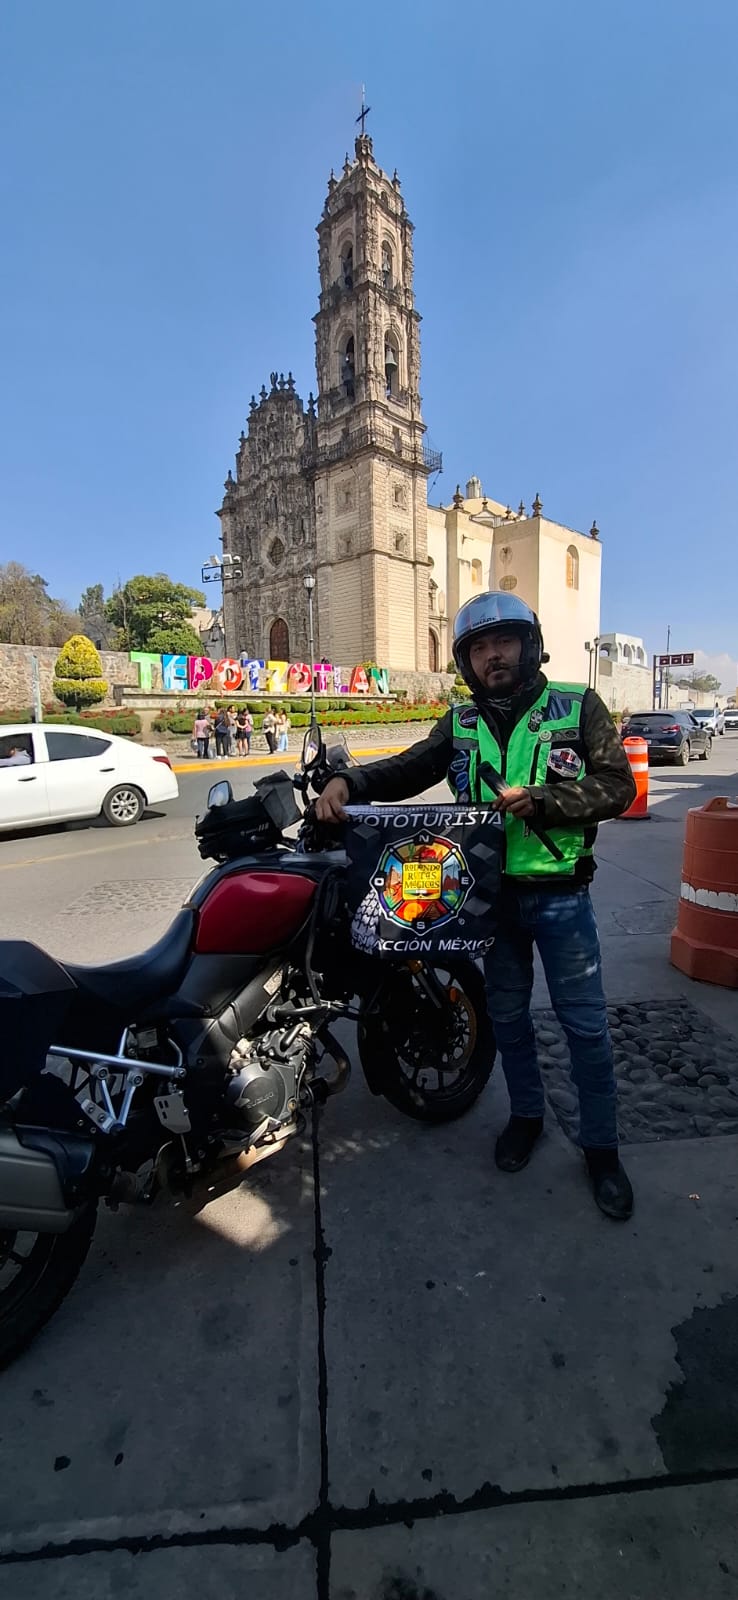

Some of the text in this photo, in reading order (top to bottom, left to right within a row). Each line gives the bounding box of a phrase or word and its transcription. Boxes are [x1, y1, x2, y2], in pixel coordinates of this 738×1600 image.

[374, 878, 385, 887] O
[461, 876, 469, 885] E
[416, 921, 426, 929] S
[438, 936, 496, 951] MÉXICO
